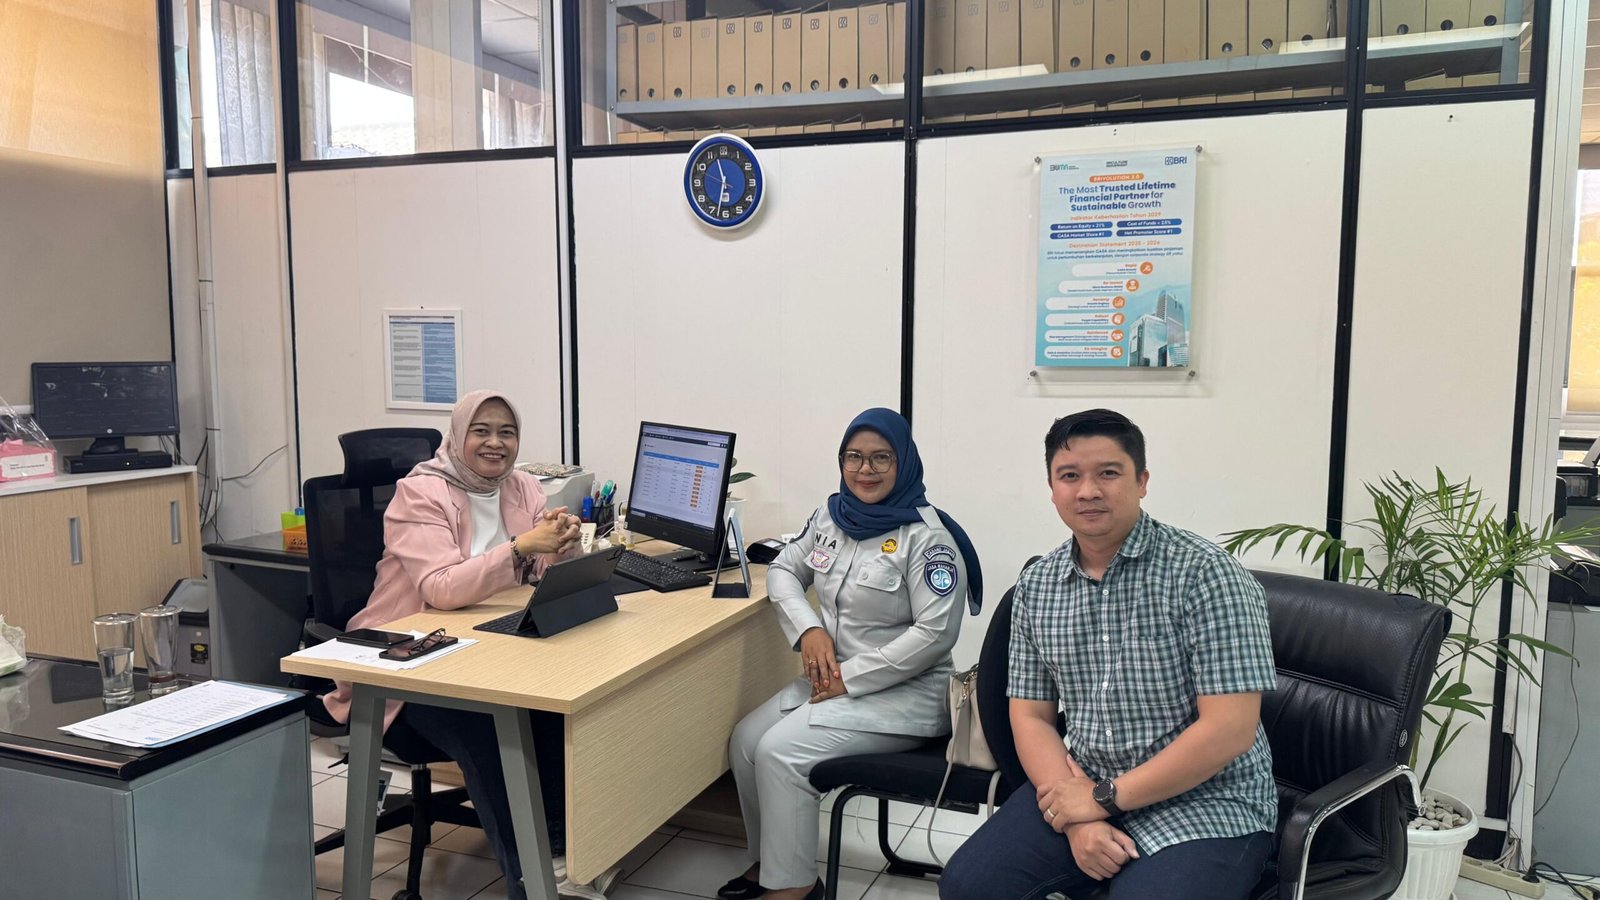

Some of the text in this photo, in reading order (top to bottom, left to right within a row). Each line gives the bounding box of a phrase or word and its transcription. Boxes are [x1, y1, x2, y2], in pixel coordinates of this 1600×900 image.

[1174, 156, 1187, 164] BRI
[696, 163, 706, 171] 10
[744, 162, 752, 170] 2
[694, 179, 701, 187] 9
[1100, 183, 1136, 192] Trusted
[1137, 181, 1176, 190] Lifetime
[698, 194, 706, 202] 8
[1069, 193, 1112, 202] Financial
[1114, 192, 1150, 200] Partner
[1071, 200, 1161, 211] Sustainable Growth
[814, 532, 837, 550] NIA
